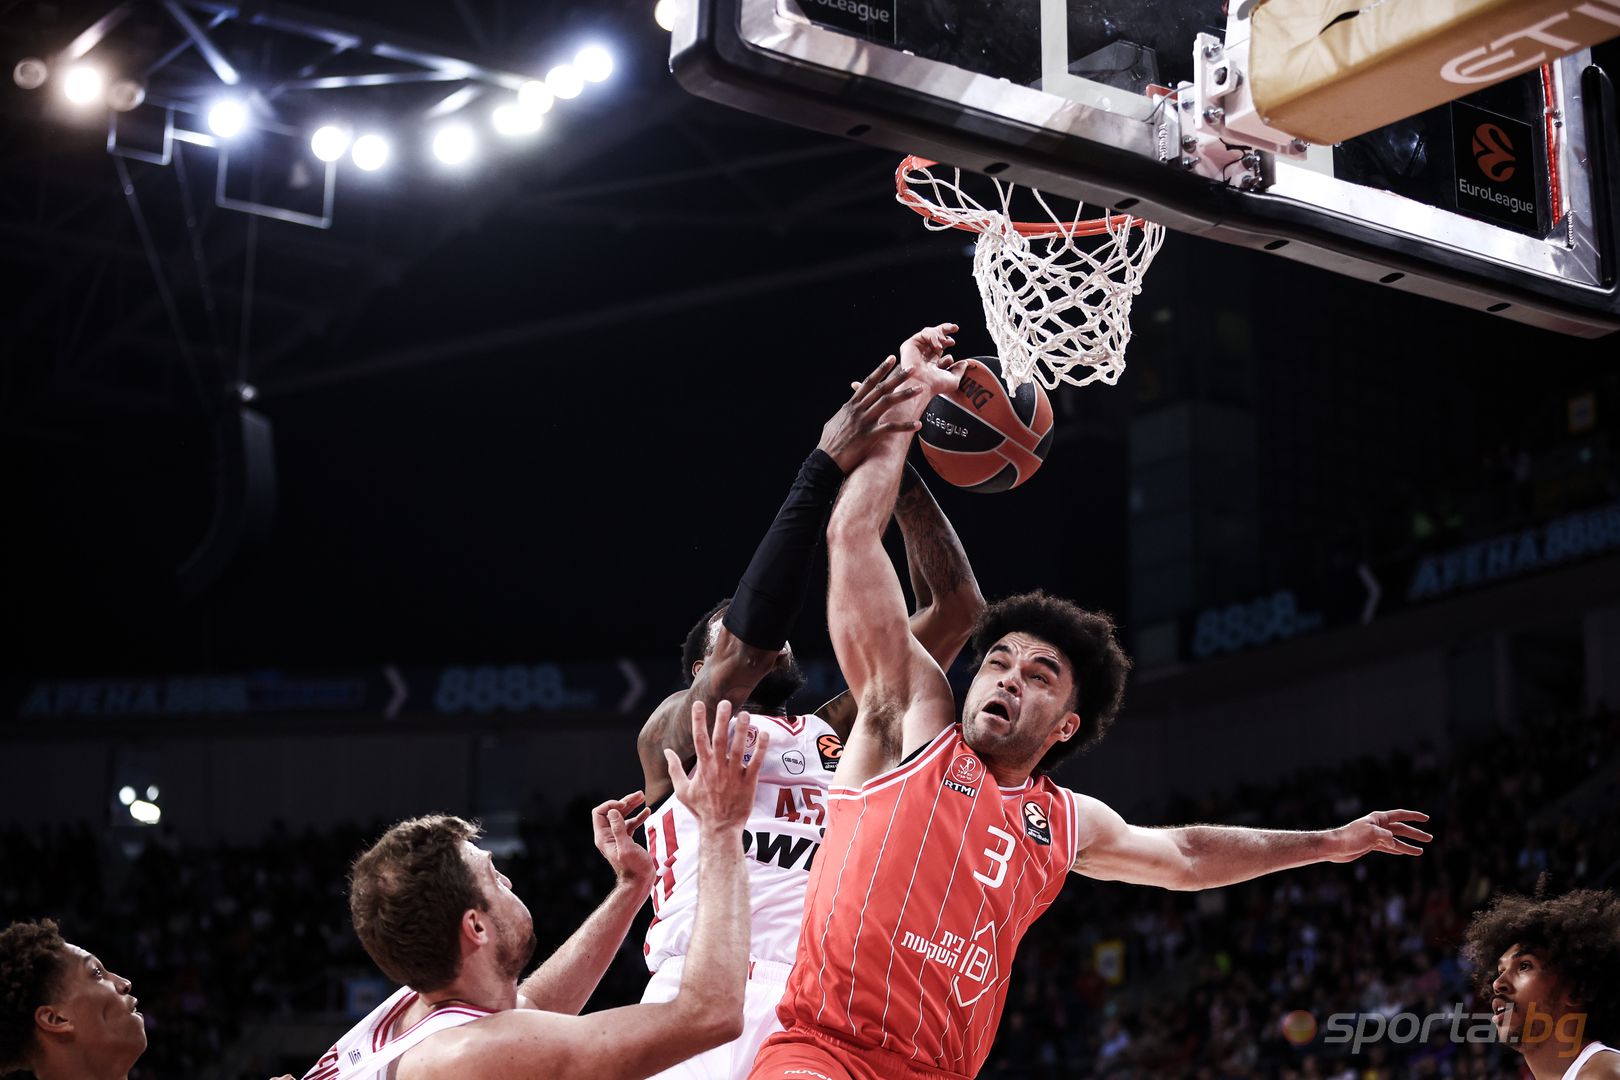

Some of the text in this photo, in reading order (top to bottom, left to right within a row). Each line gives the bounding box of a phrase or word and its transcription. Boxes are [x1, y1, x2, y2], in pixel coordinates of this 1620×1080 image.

[1459, 178, 1534, 214] EuroLeague
[944, 779, 976, 797] RTMI
[775, 788, 826, 826] 45
[973, 825, 1016, 889] 3
[901, 931, 959, 969] השקעות
[940, 930, 965, 954] בית
